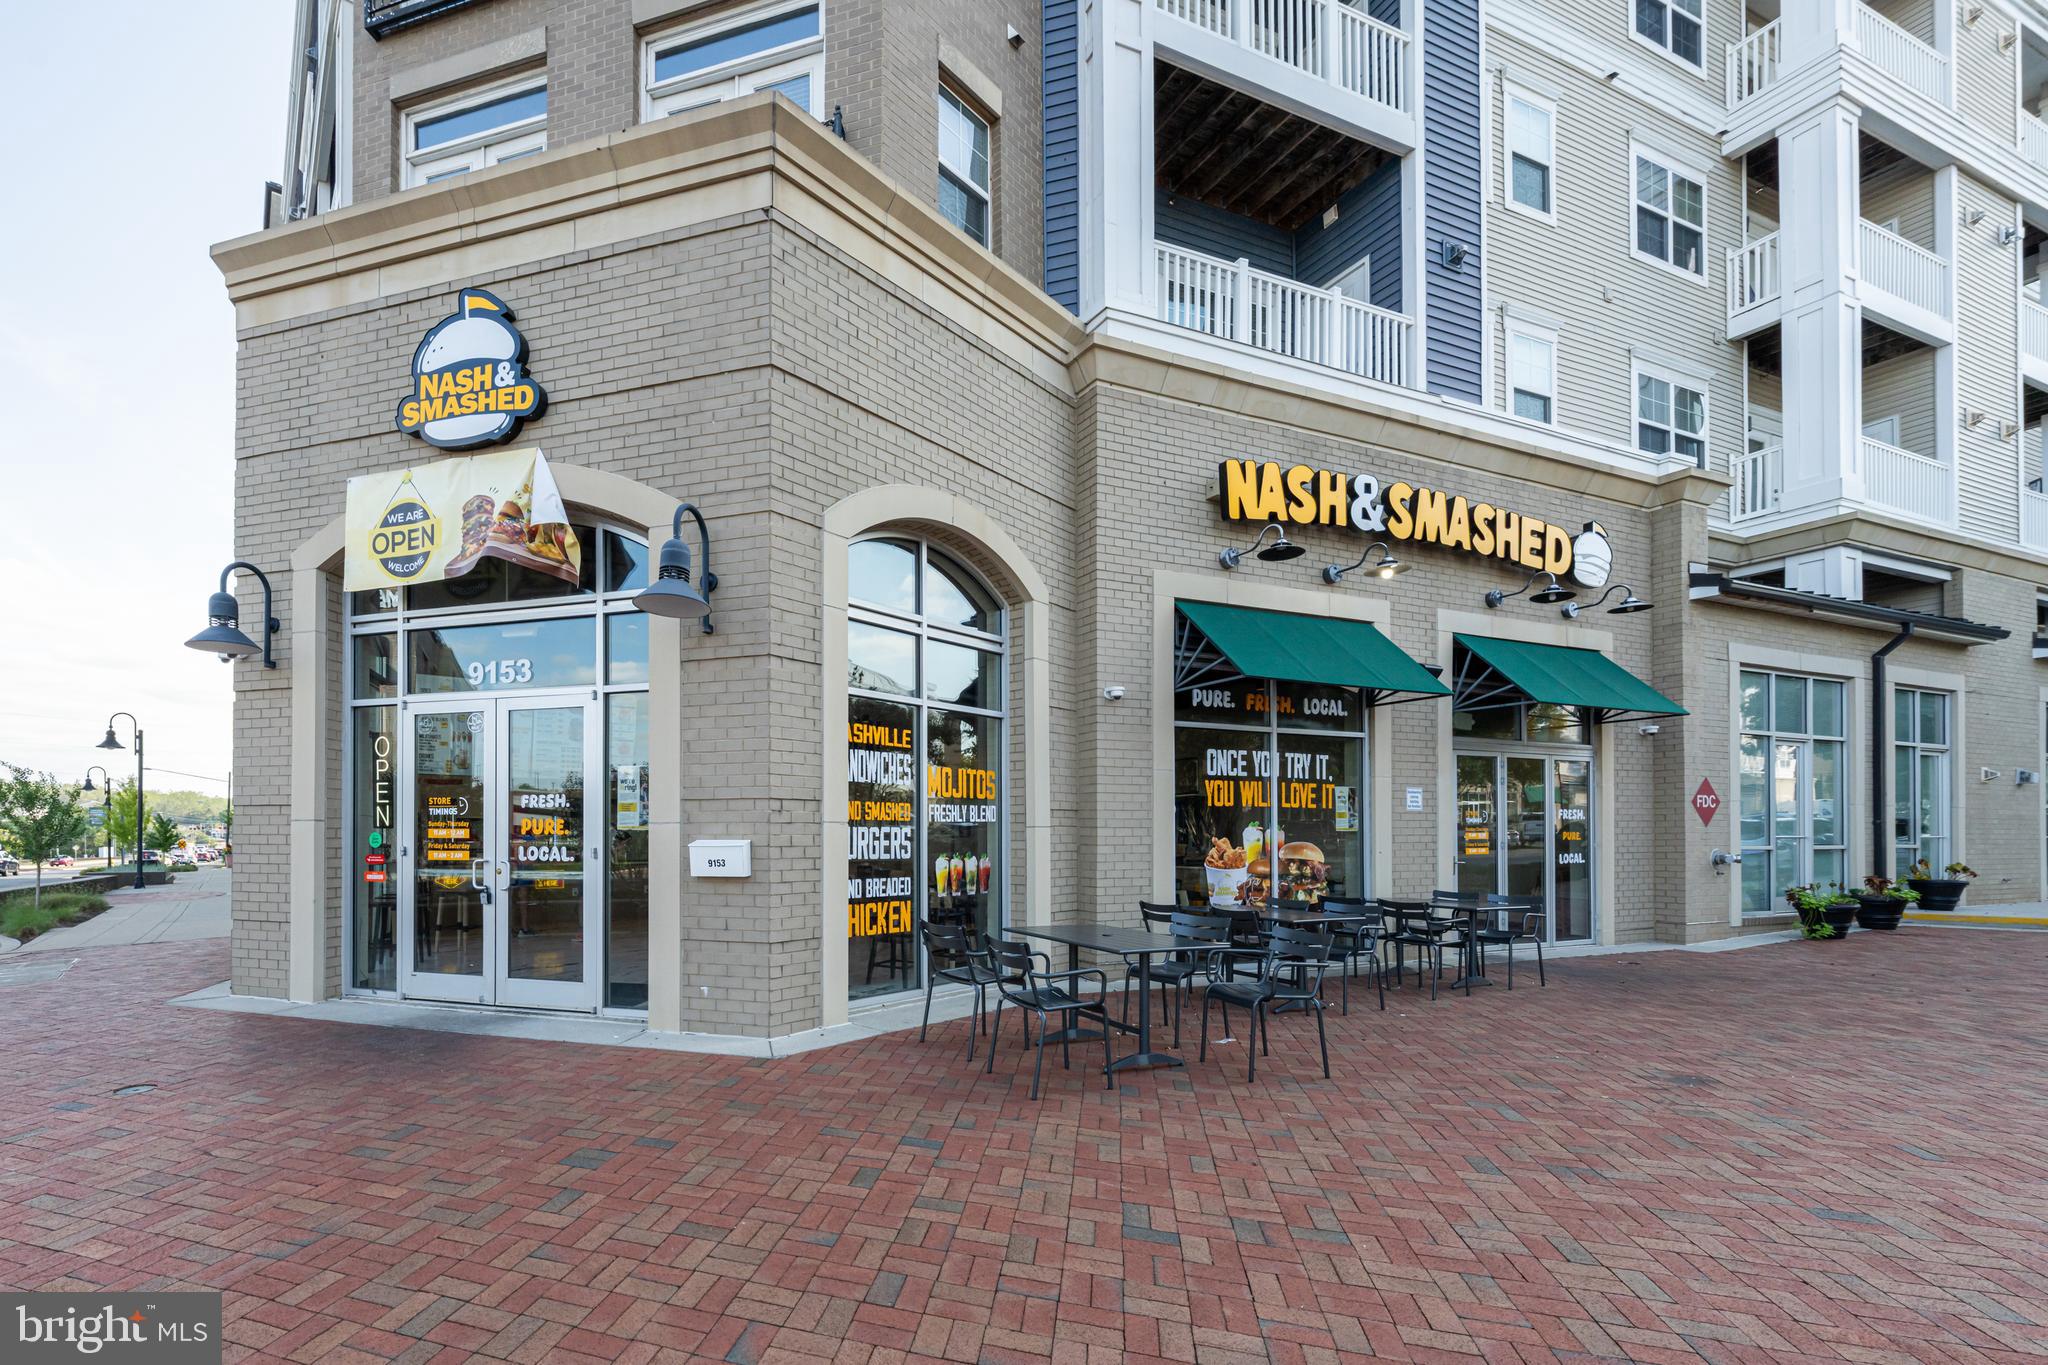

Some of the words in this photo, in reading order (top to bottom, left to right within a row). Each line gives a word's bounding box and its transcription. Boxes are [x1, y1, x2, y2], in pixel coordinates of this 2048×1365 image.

[420, 364, 492, 400] NASH
[494, 361, 516, 387] &
[402, 384, 534, 427] SMASHED
[388, 513, 404, 524] WE
[406, 508, 424, 521] ARE
[1223, 458, 1348, 526] NASH
[1350, 474, 1386, 532] &
[1386, 482, 1573, 576] SMASHED
[372, 524, 434, 555] OPEN
[388, 556, 424, 572] WELCOME
[468, 658, 532, 685] 9153
[1192, 688, 1235, 708] PURE.
[1303, 698, 1348, 716] LOCAL.
[848, 722, 912, 749] SHVILLE
[848, 749, 912, 786] NDWICHES
[1206, 749, 1247, 776] ONCE
[1285, 752, 1311, 780] TRY
[1316, 754, 1333, 782] IT,
[375, 736, 390, 827] OPEN
[928, 764, 996, 800] MOJITOS
[1204, 780, 1234, 807] YOU
[1281, 782, 1317, 809] LOVE
[1322, 783, 1335, 809] IT
[428, 797, 451, 805] STORE
[520, 794, 570, 808] FRESH.
[848, 800, 861, 820] ND
[865, 801, 911, 821] SMASHED
[928, 804, 967, 822] FRESHLY
[970, 805, 996, 822] BLEND
[1559, 808, 1585, 820] FRESH.
[1696, 795, 1716, 808] FDC
[521, 818, 570, 835] PURE.
[518, 846, 574, 862] LOCAL.
[848, 826, 912, 860] URGERS
[708, 859, 726, 867] 9153
[1559, 853, 1585, 864] LOCAL.
[848, 878, 862, 898] ND
[866, 876, 911, 898] BREADED
[848, 900, 912, 938] HICKEN
